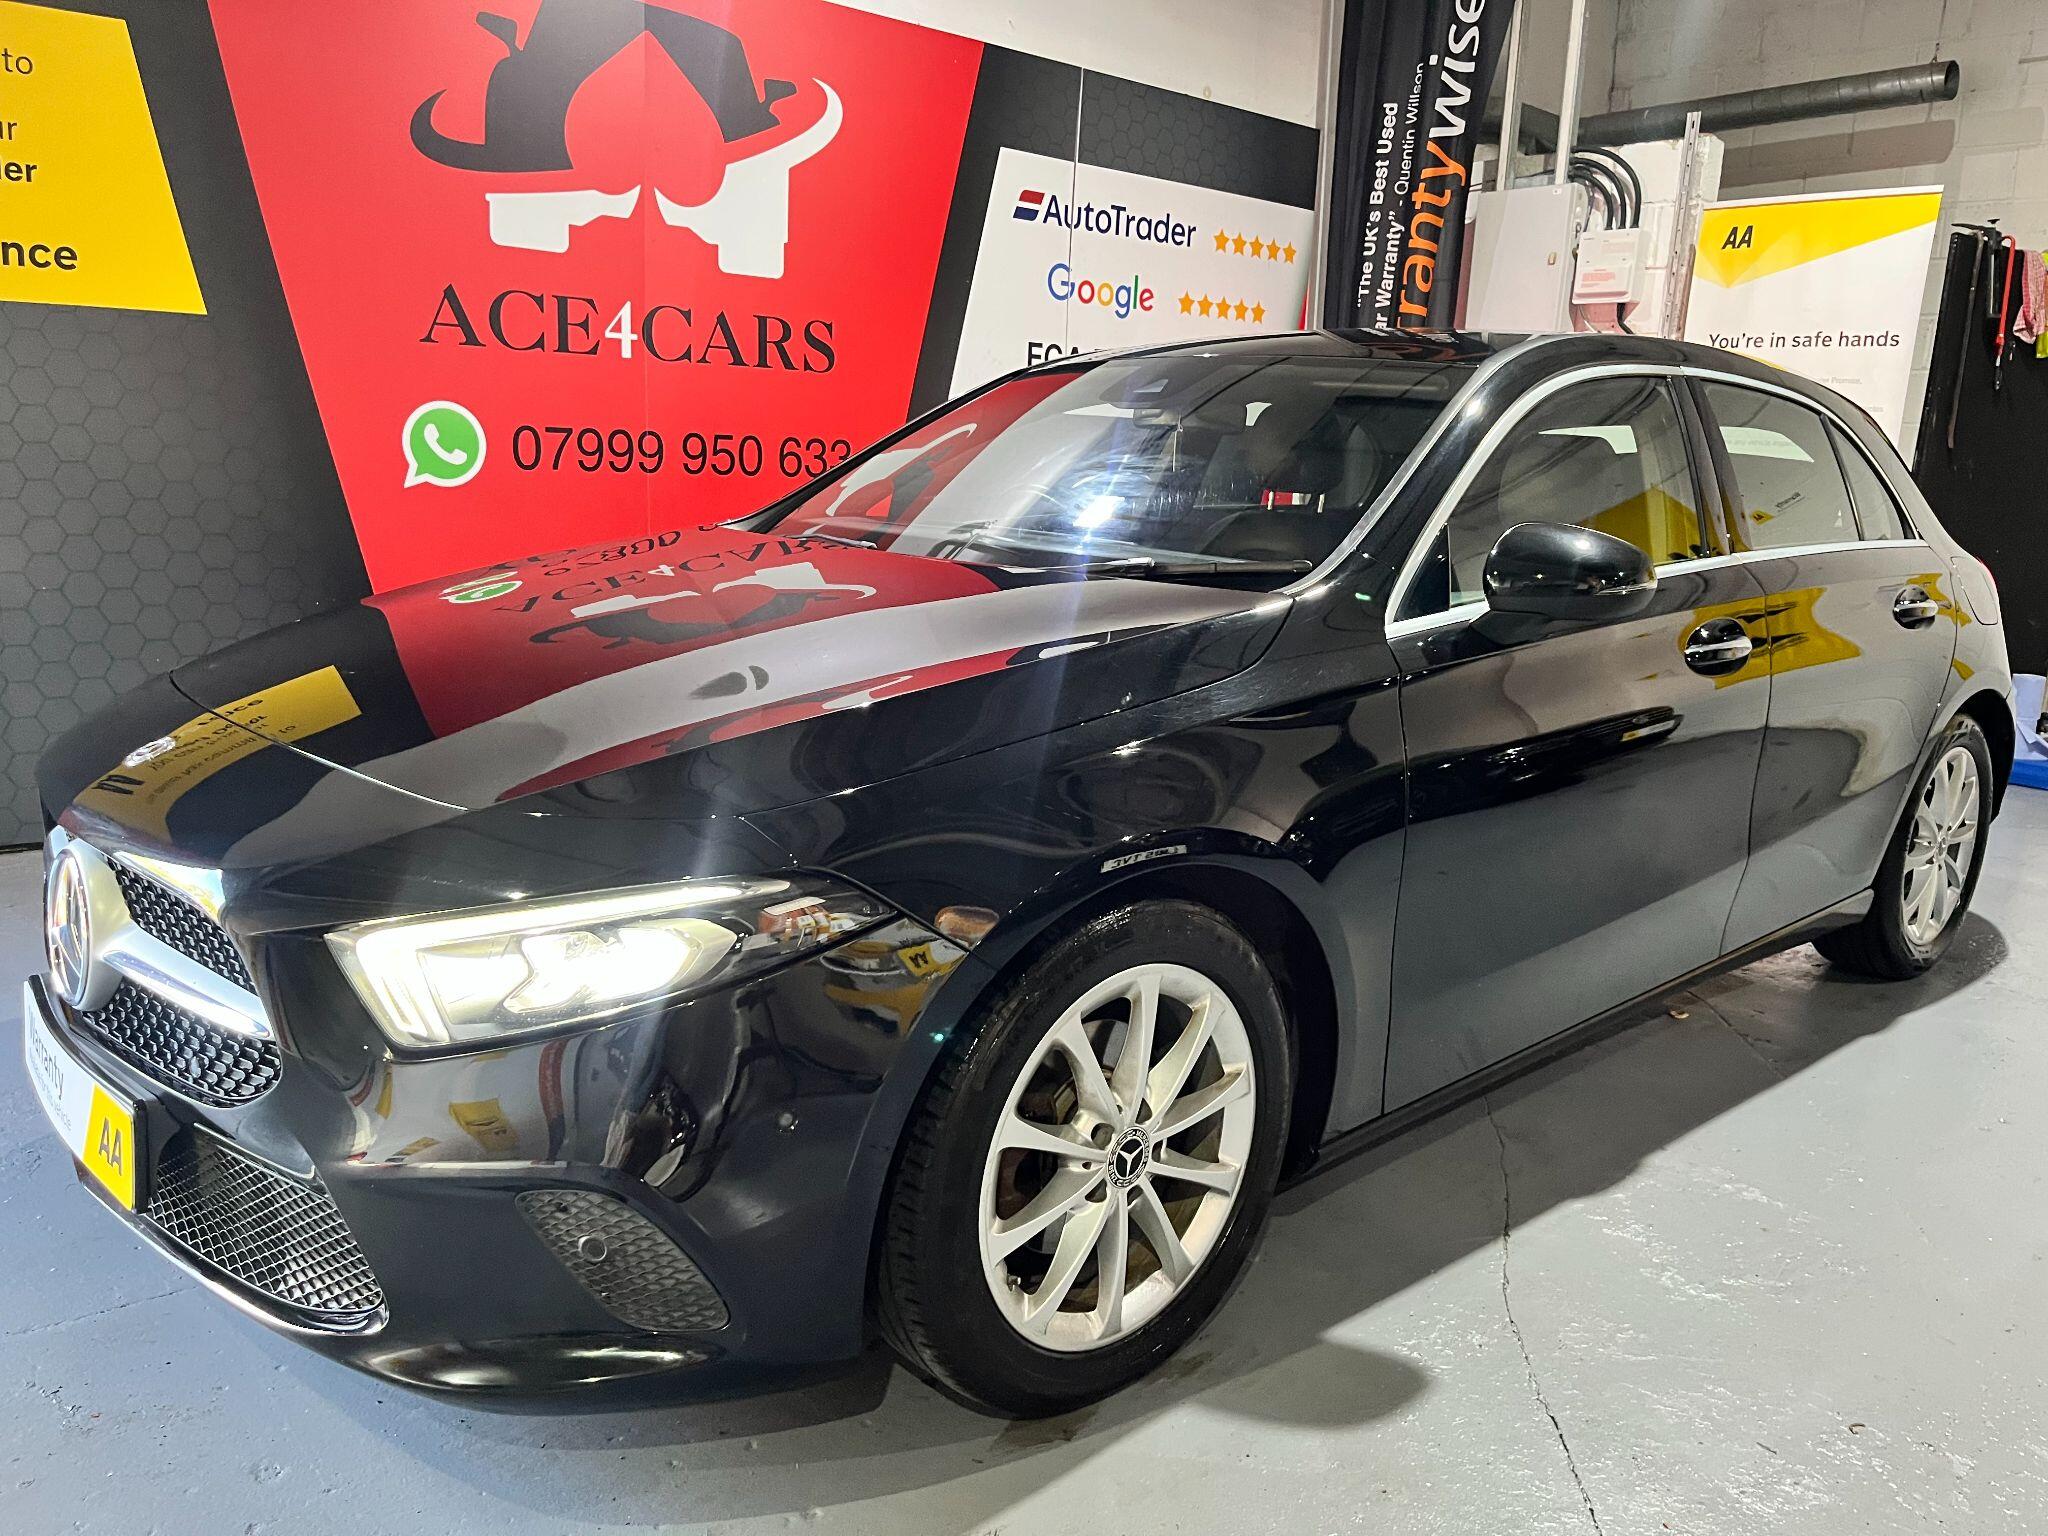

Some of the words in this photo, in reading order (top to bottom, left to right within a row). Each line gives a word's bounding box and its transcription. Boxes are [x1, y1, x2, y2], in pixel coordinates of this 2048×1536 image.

[2, 48, 33, 75] to
[1376, 102, 1399, 154] Used
[1394, 129, 1416, 195] Quentin
[1405, 62, 1424, 124] Willson
[1370, 159, 1390, 205] Best
[1042, 194, 1197, 248] AutoTrader
[1721, 225, 1754, 250] AA
[1047, 262, 1154, 319] Google
[419, 283, 836, 374] ACE4CARS
[1708, 333, 1764, 349] You're
[1769, 332, 1786, 348] in
[1791, 331, 1832, 348] safe
[1838, 331, 1900, 348] hands
[512, 425, 664, 474] 07999
[682, 433, 763, 477] 950
[98, 1116, 122, 1177] AA
